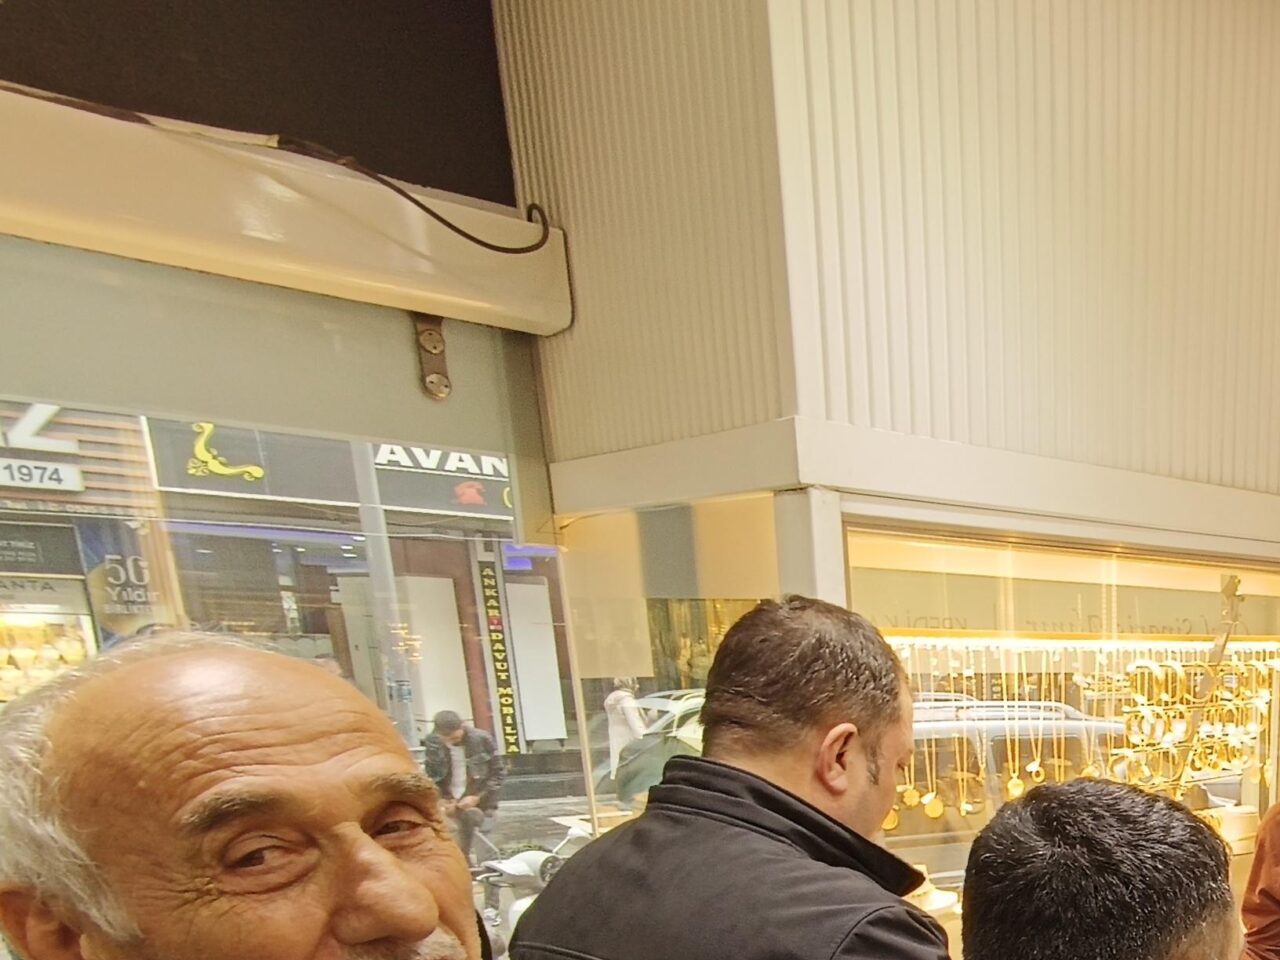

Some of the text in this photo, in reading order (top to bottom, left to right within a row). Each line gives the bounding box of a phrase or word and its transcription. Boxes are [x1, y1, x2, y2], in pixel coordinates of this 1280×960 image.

[3, 463, 64, 485] 1974
[375, 443, 509, 478] AVAN
[490, 633, 509, 680] DAVUT
